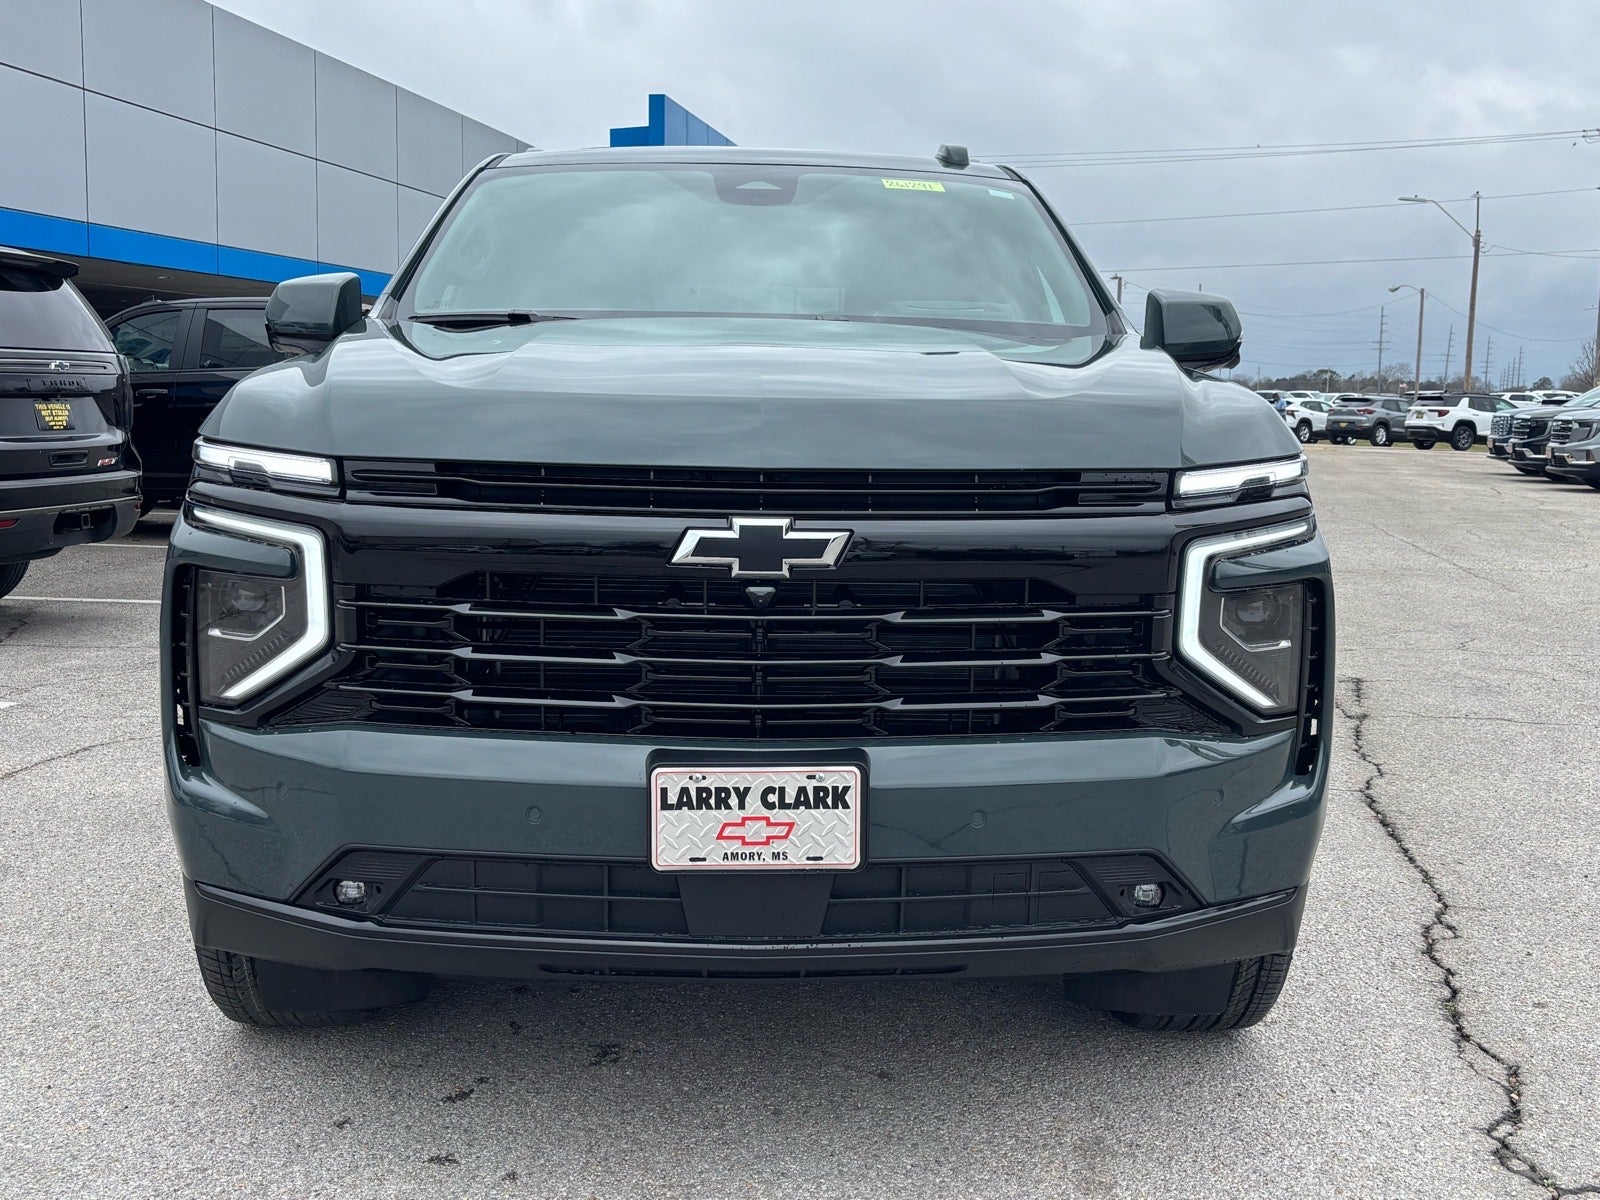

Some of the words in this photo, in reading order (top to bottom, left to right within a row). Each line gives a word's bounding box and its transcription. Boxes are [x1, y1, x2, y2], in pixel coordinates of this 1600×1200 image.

[659, 786, 752, 811] LARRY
[760, 785, 852, 810] CLARK
[722, 852, 766, 862] AMORY,
[771, 851, 789, 861] MS
